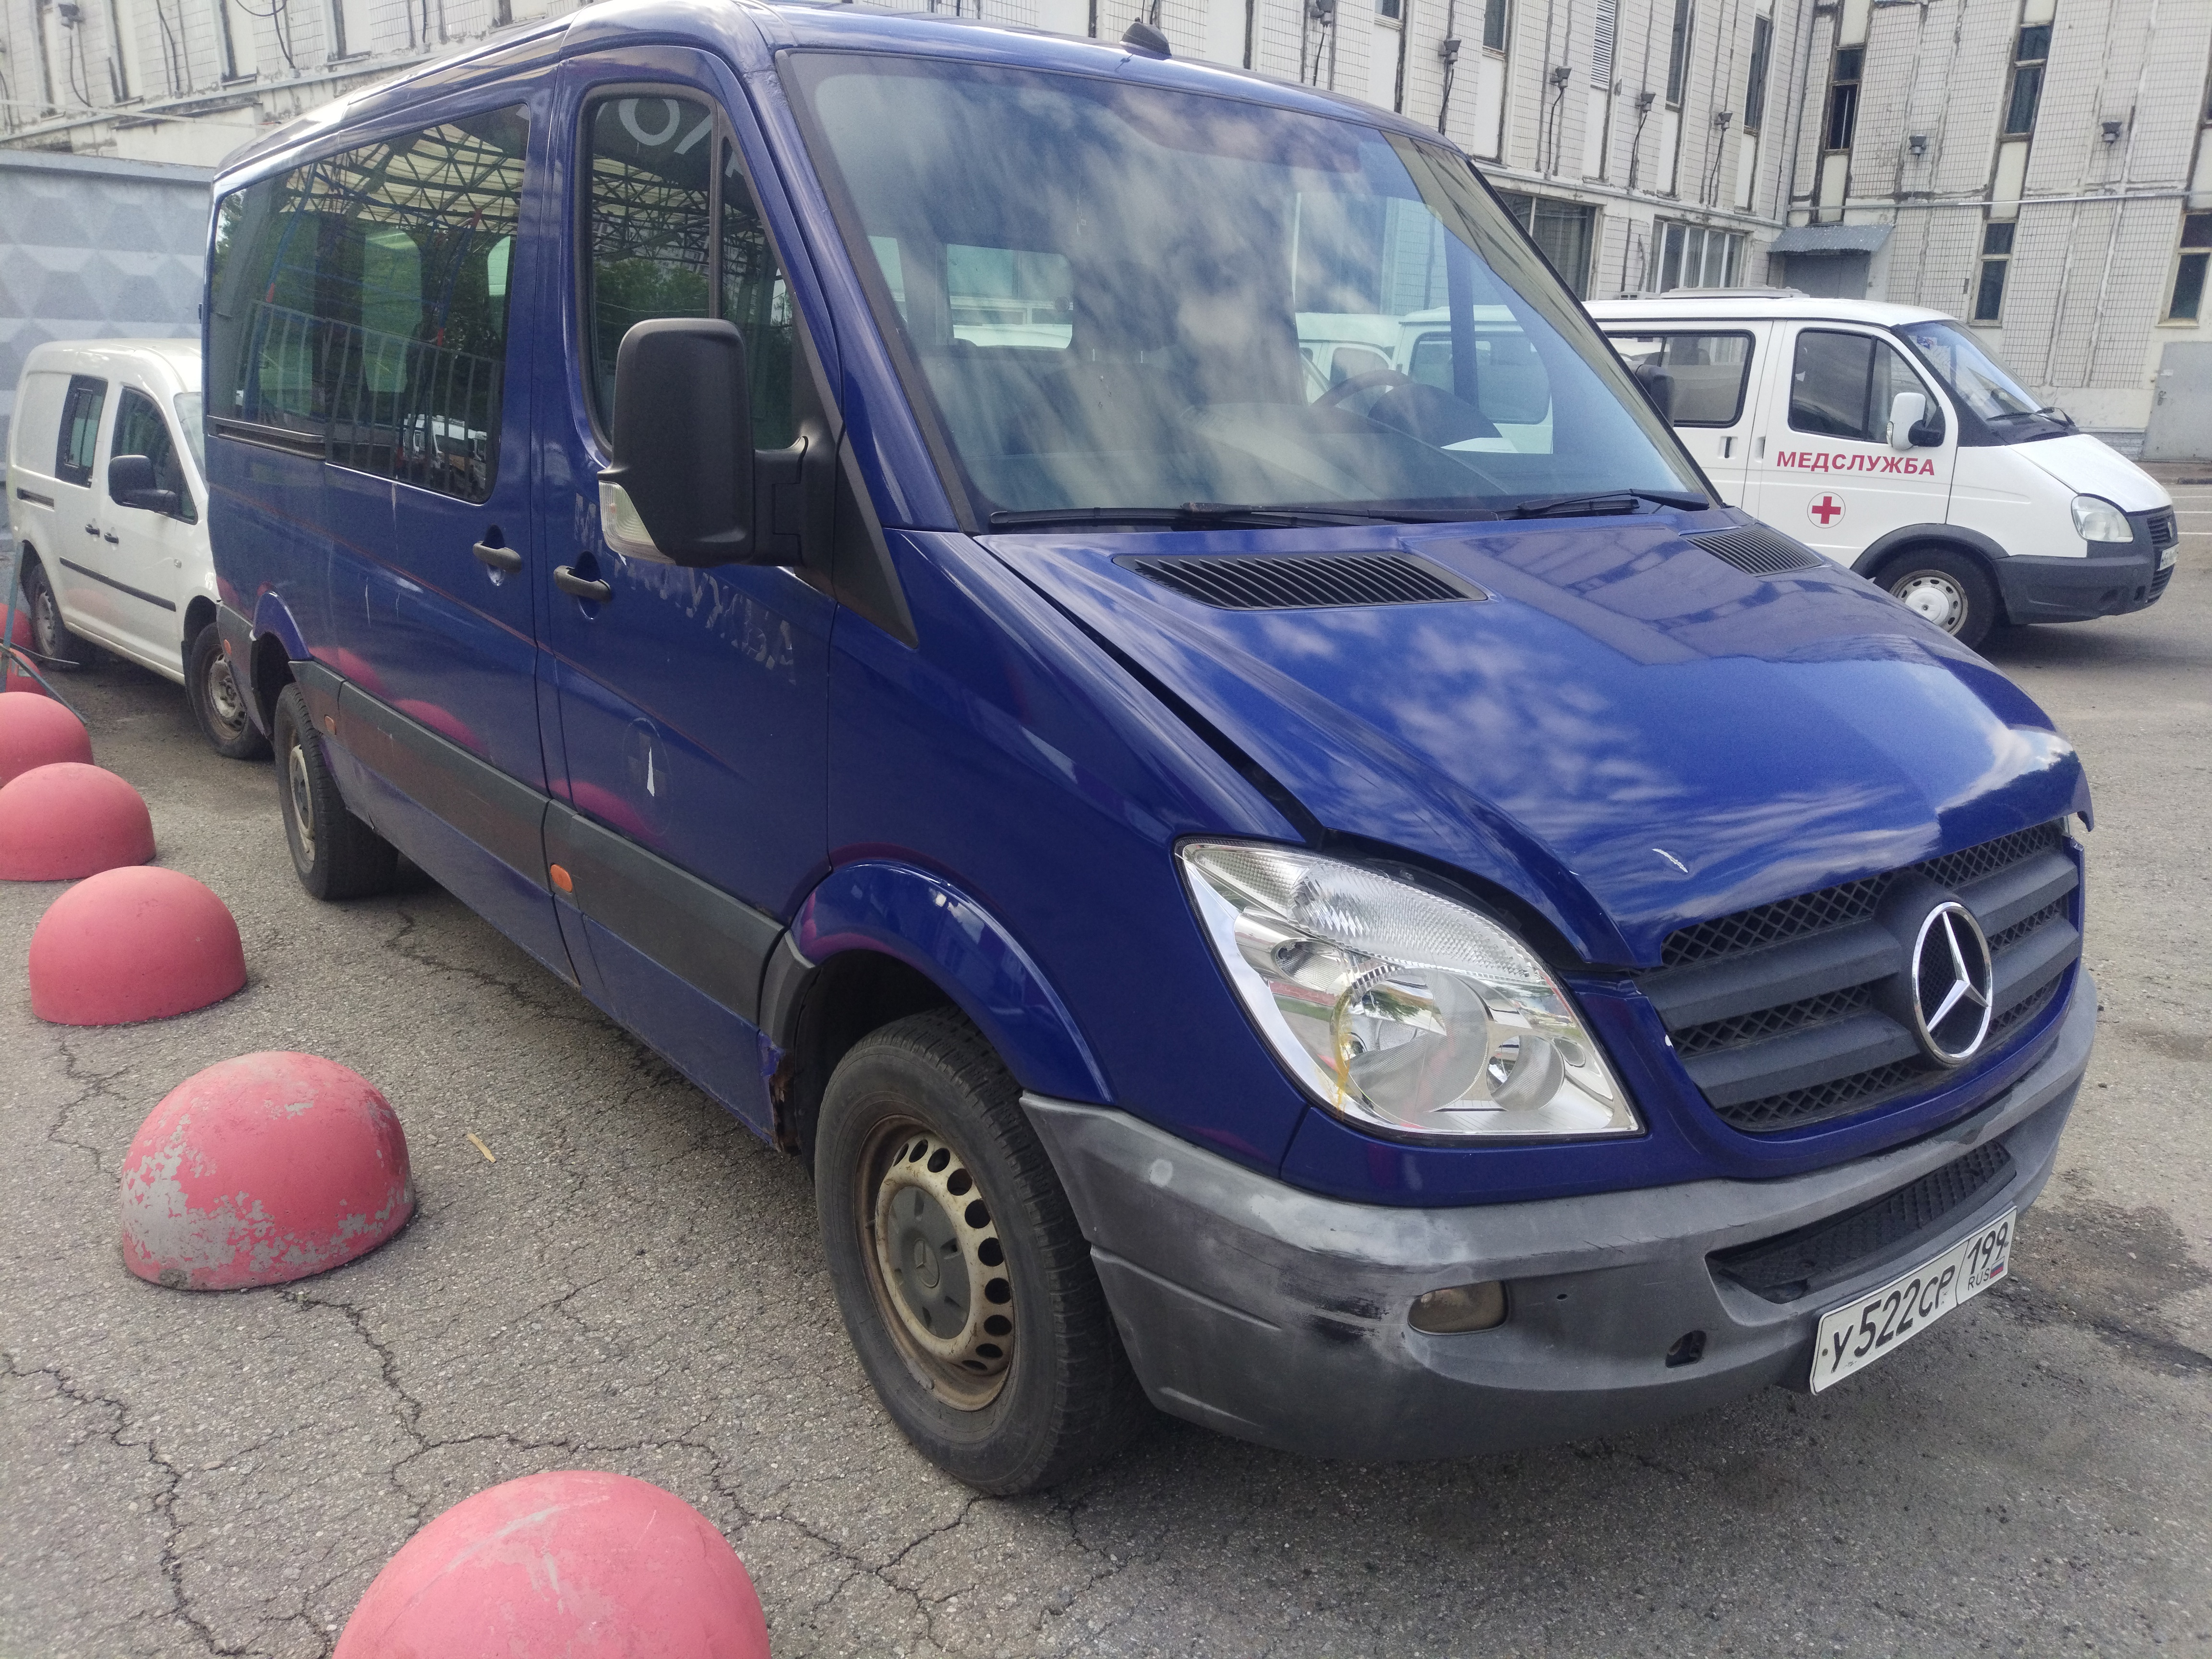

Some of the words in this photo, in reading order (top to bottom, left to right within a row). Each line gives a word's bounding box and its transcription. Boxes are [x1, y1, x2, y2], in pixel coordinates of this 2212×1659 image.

[1777, 451, 1935, 476] МЕДСЛУЖБА
[1968, 1268, 1990, 1291] RUS
[1830, 1264, 1956, 1373] У522СР
[1967, 1221, 2008, 1275] 199
